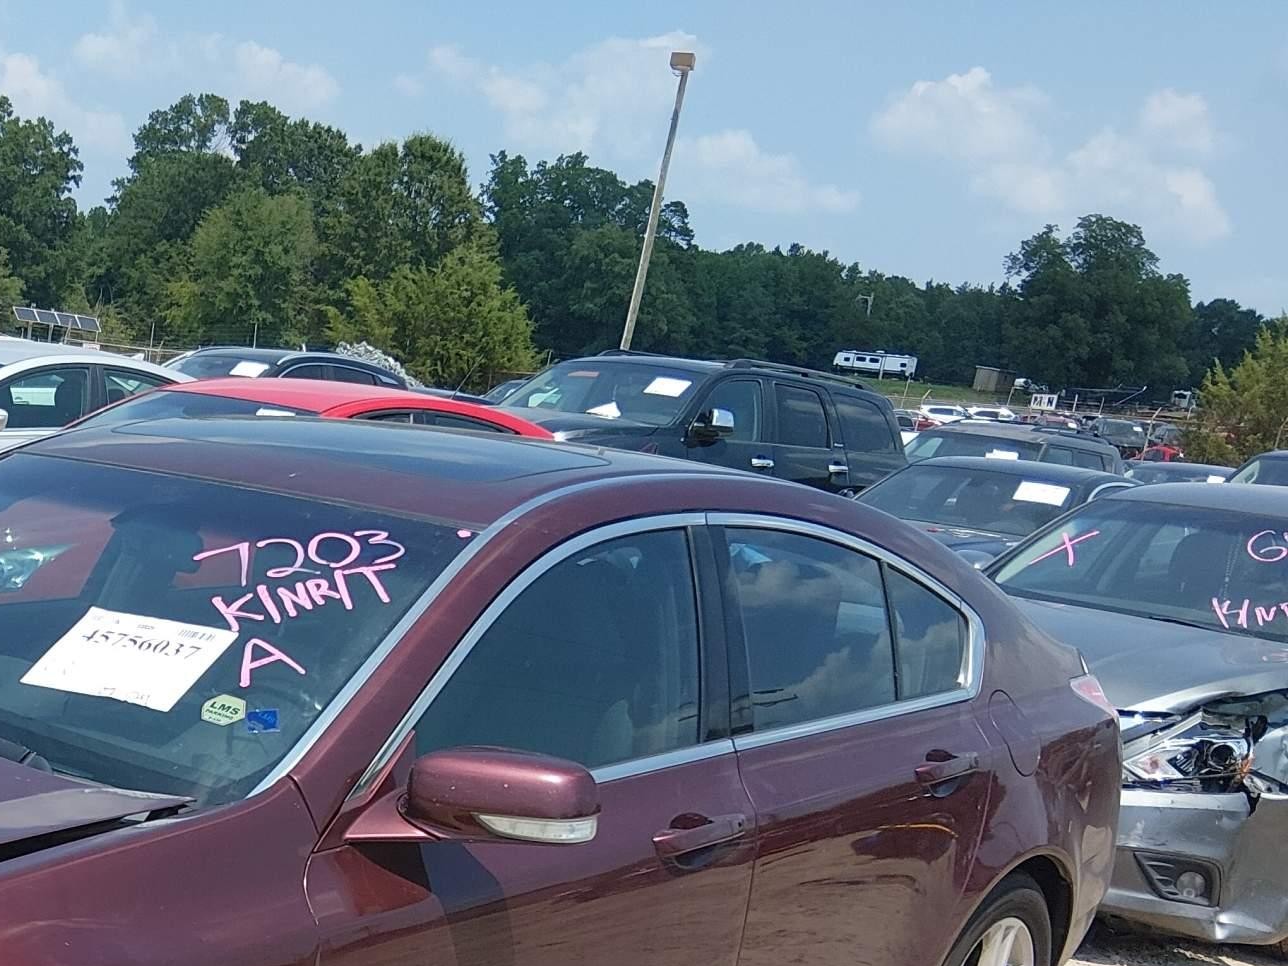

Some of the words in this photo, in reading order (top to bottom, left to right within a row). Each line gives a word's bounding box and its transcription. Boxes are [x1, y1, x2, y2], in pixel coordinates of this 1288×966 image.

[193, 529, 406, 588] 7203
[81, 629, 203, 660] 45756037
[239, 637, 307, 688] A
[209, 701, 241, 716] LMS
